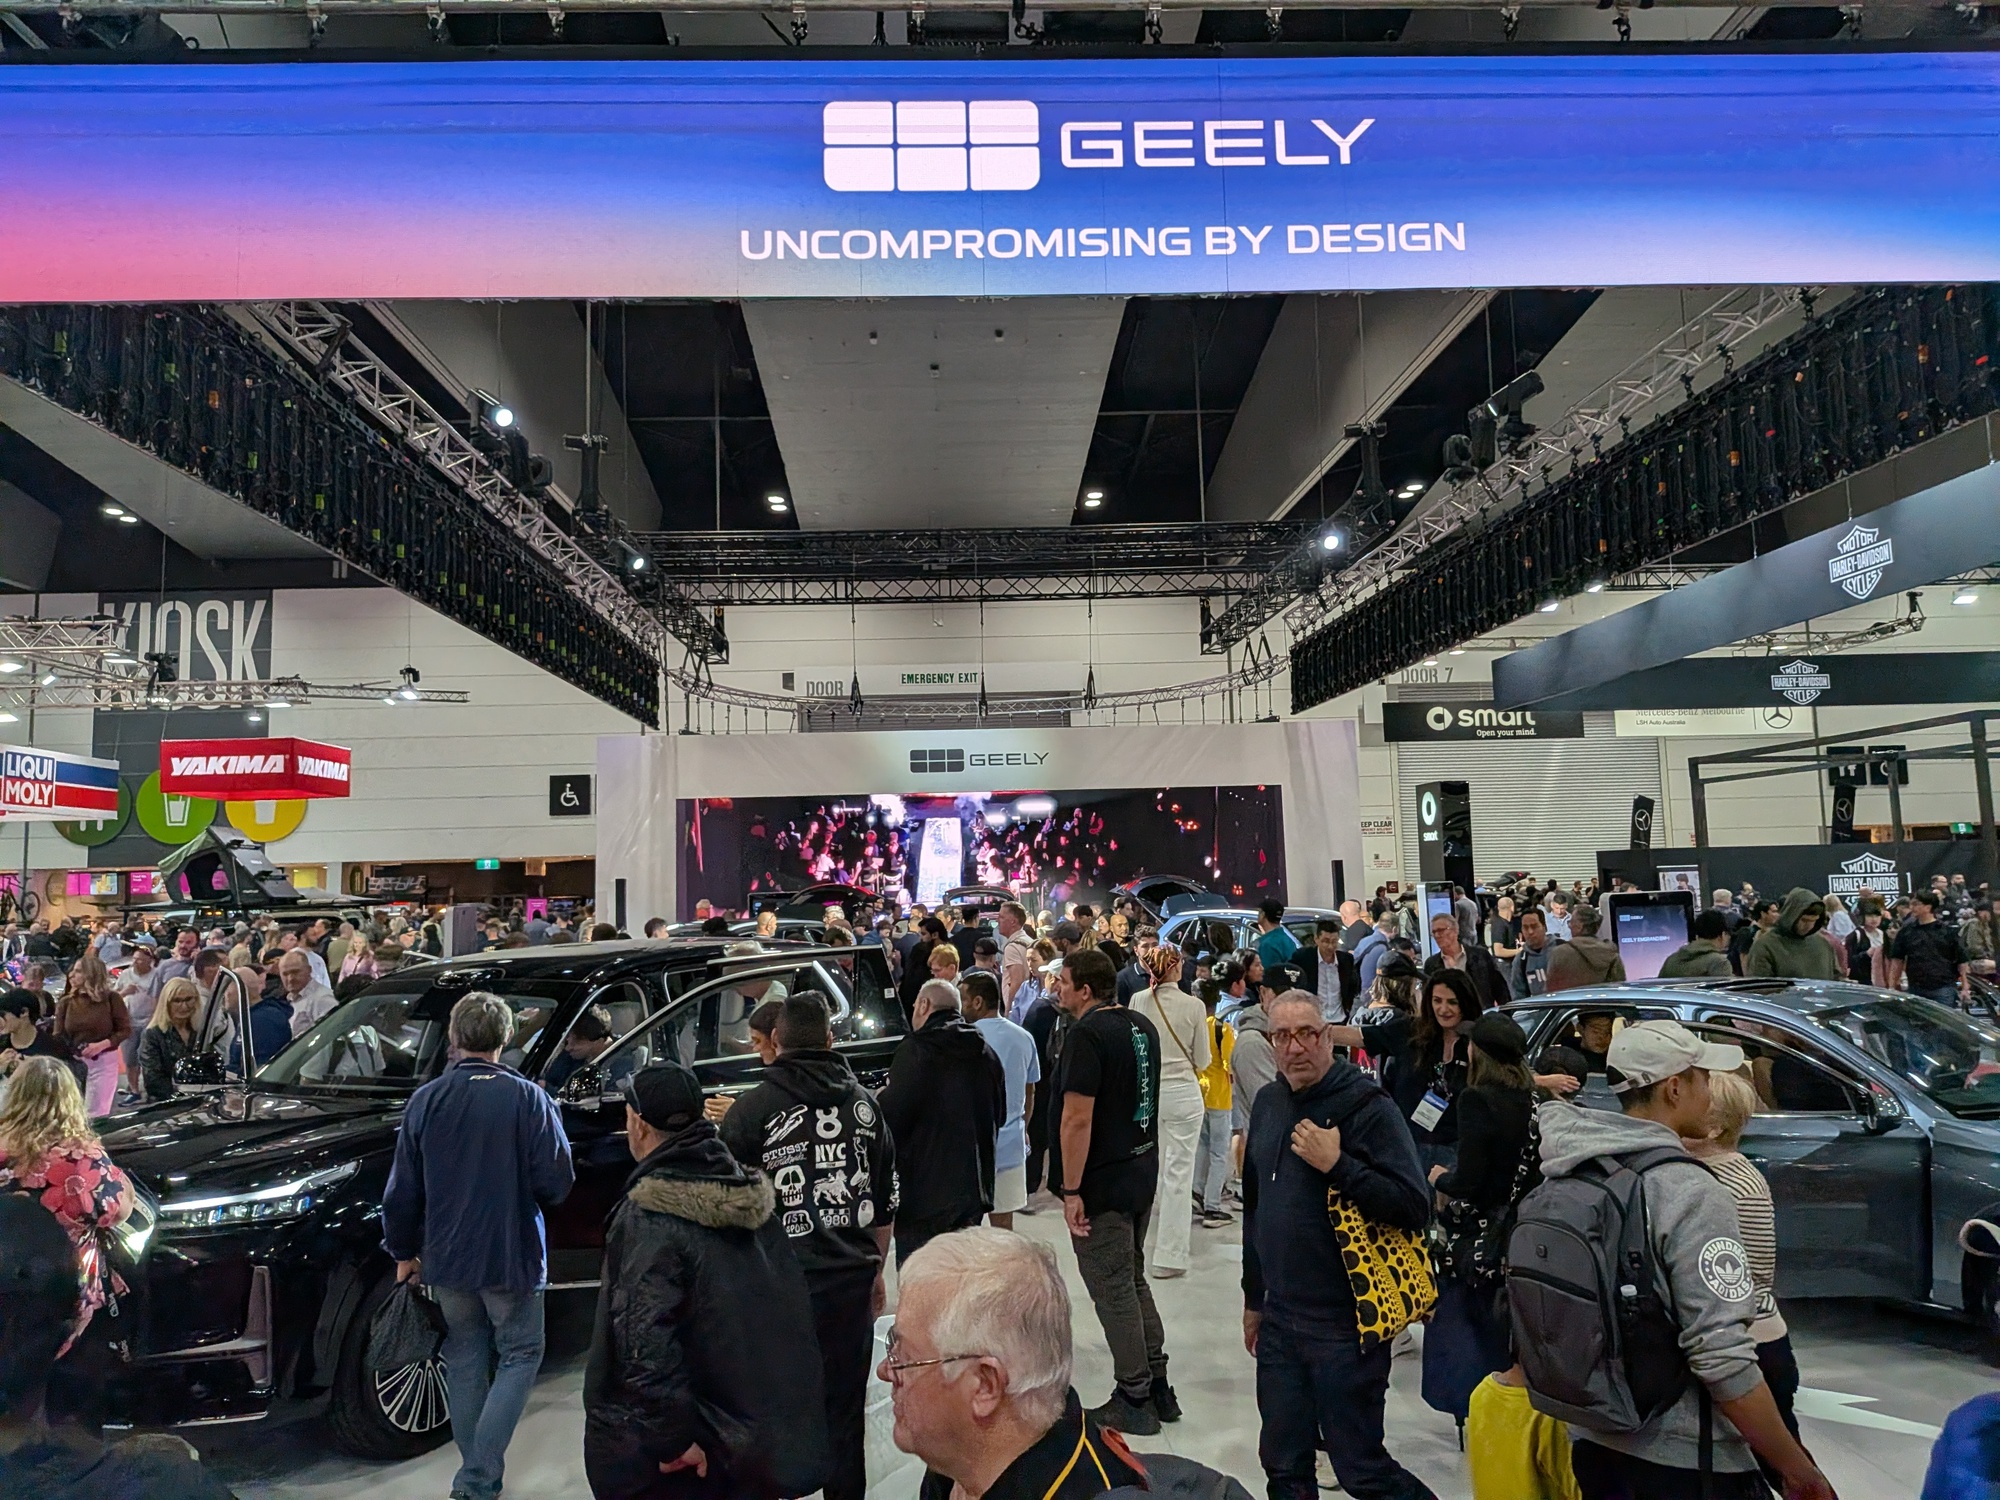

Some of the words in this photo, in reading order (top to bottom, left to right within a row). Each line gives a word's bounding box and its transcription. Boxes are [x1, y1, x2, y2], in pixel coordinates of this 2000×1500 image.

[1060, 118, 1376, 168] GEELY
[740, 225, 1193, 261] UNCOMPROMISING
[1205, 224, 1274, 256] BY
[1287, 222, 1467, 254] DESIGN
[1842, 530, 1874, 554] MOTOR
[1831, 543, 1890, 578] HARLEY-DAVIDSON
[1846, 569, 1877, 595] CYCLES
[99, 599, 267, 711] KIOSK
[901, 672, 955, 685] EMERGENCY
[958, 672, 979, 684] EXIT
[1401, 668, 1439, 684] DOOR
[1445, 667, 1454, 683] 7
[1785, 663, 1814, 674] MOTOR
[806, 680, 844, 697] DOOR
[1773, 676, 1828, 687] HARLEY-DAVIDSON
[1787, 689, 1817, 702] CYCLES
[1457, 708, 1537, 727] smart
[1476, 729, 1496, 738] Open
[1497, 730, 1515, 738] your
[1515, 728, 1537, 736] mind.
[6, 753, 53, 780] LIQUI
[170, 754, 286, 777] YAKIMA
[297, 755, 349, 782] YAKIMA
[969, 752, 1049, 766] GEELY
[5, 779, 53, 806] MOLY
[1373, 820, 1393, 828] CLEAR
[1848, 856, 1889, 873] MOTOR
[1832, 876, 1900, 892] HARLEY-DAVIDS
[762, 1141, 810, 1164] STUSSY
[815, 1142, 847, 1163] NYC
[785, 1222, 810, 1233] SPORT
[821, 1215, 849, 1229] 1980
[1703, 1240, 1748, 1264] RUNDMC
[1709, 1278, 1751, 1300] ADIDAS
